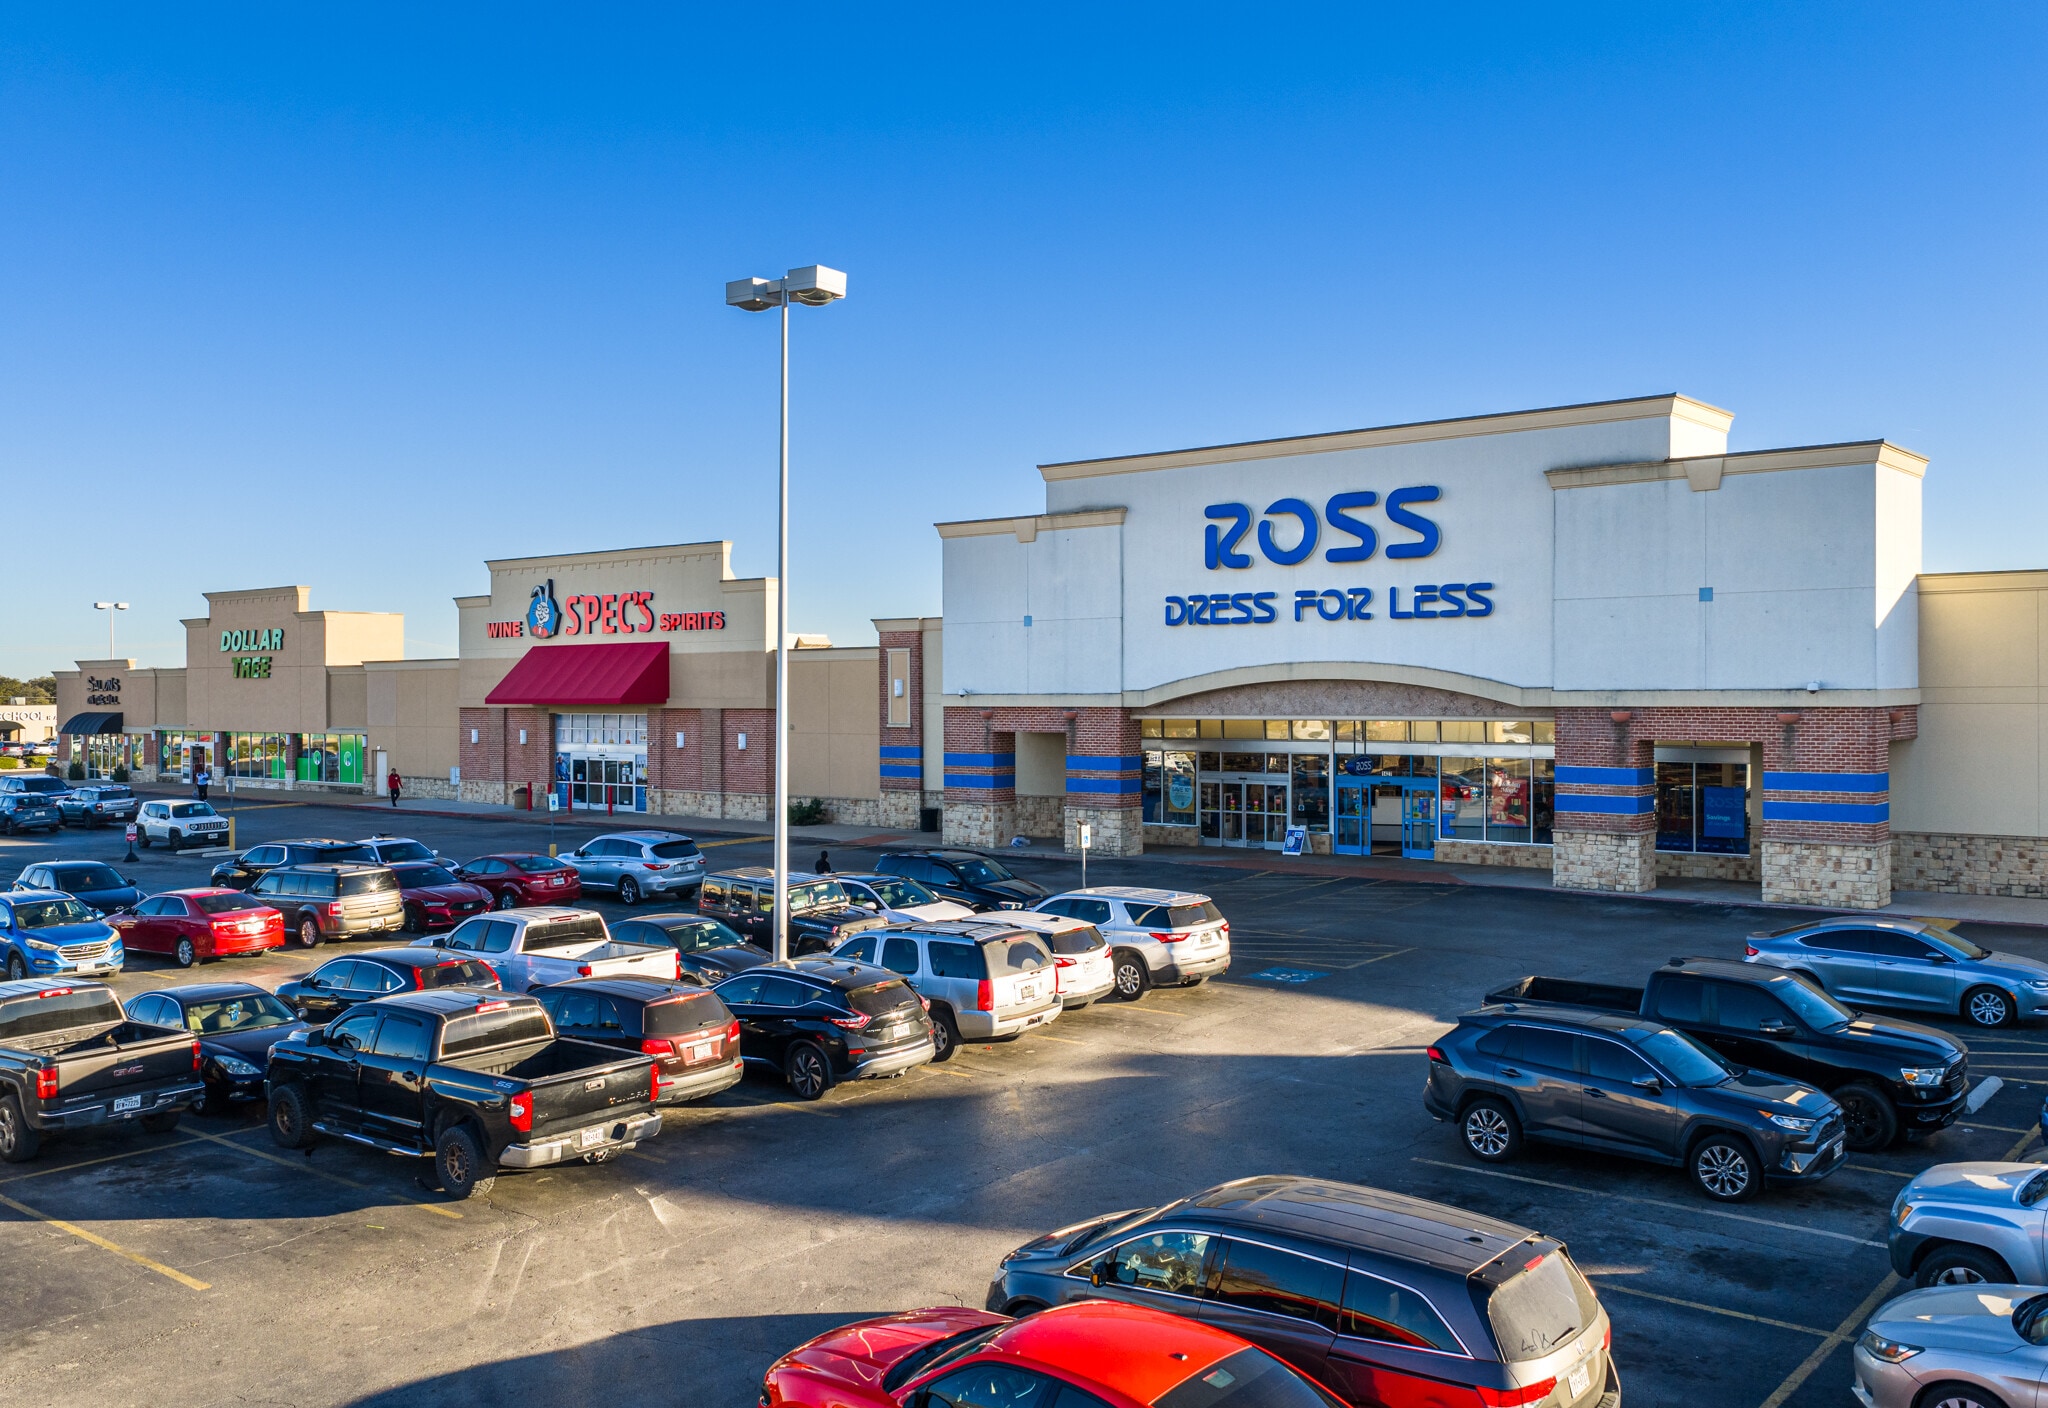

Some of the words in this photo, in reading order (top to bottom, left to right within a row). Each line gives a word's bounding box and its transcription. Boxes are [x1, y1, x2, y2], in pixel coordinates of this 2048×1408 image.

[1204, 485, 1443, 570] ROSS
[486, 620, 523, 639] WINE
[565, 591, 654, 636] SPEC'S
[659, 610, 725, 632] SPIRITS
[1165, 591, 1279, 626] DRESS
[1294, 588, 1375, 622] FOR
[1389, 582, 1496, 619] LESS
[219, 628, 284, 651] DOLLAR
[231, 656, 273, 678] TREE
[0, 711, 44, 721] CHOOL
[1355, 760, 1373, 771] ROSS
[113, 1065, 143, 1077] GMC
